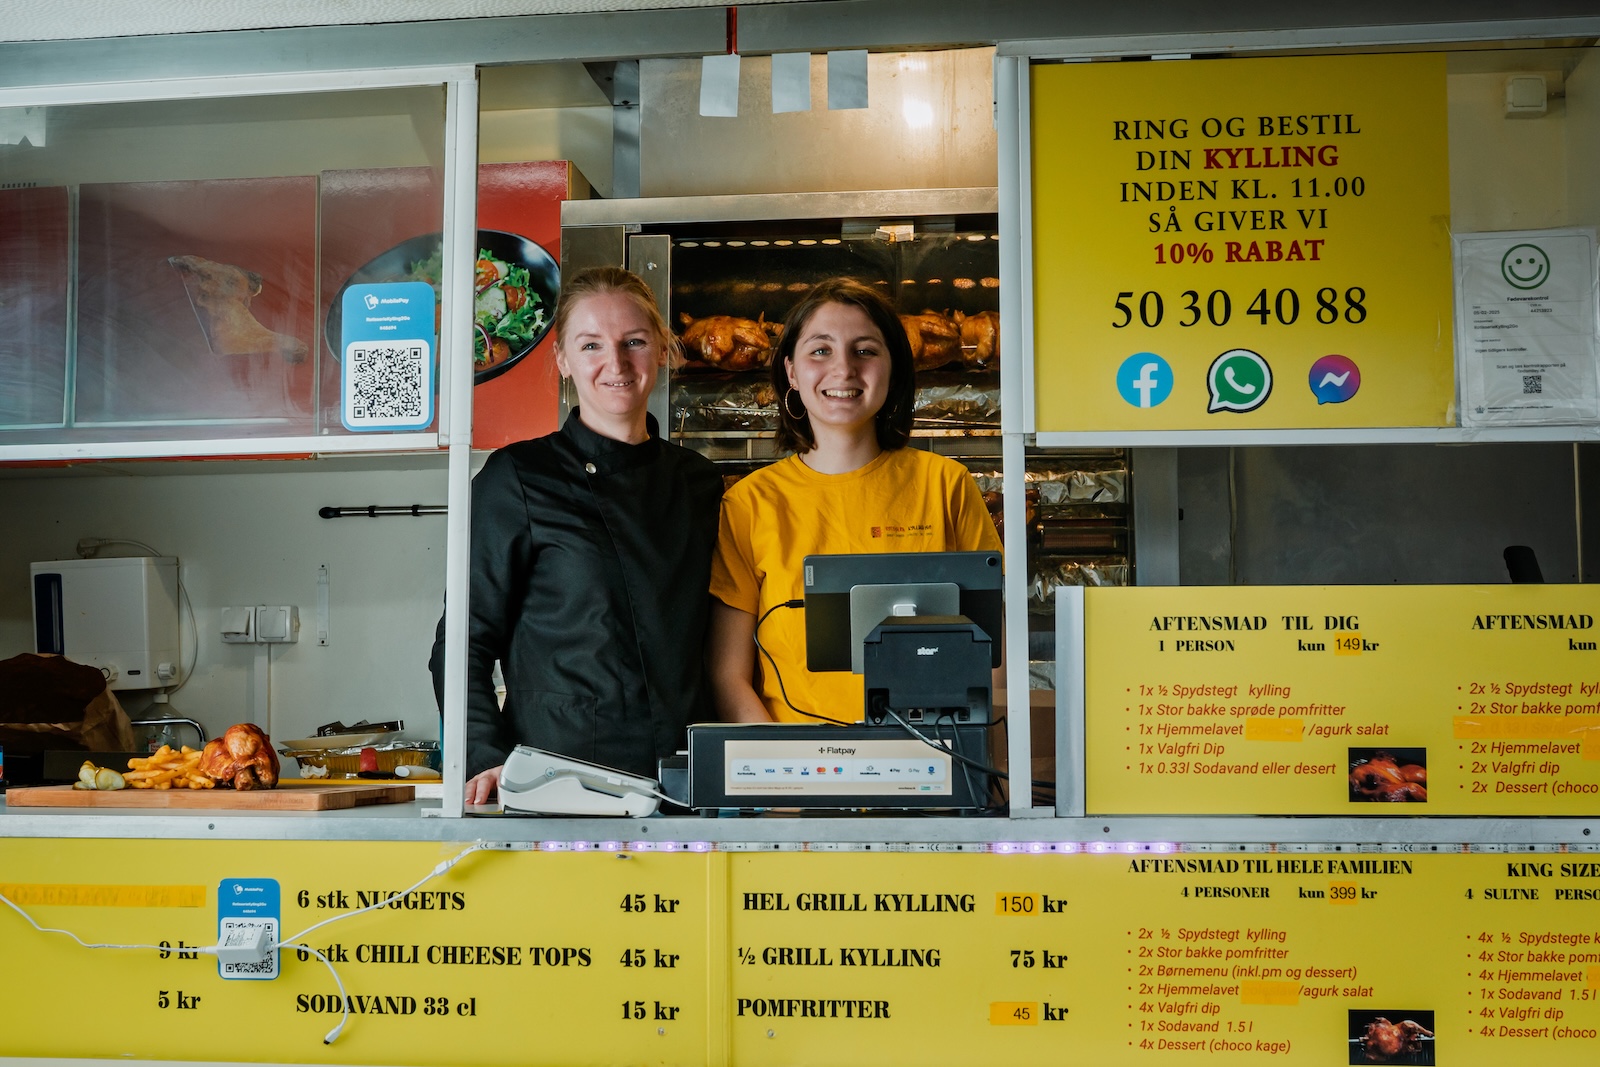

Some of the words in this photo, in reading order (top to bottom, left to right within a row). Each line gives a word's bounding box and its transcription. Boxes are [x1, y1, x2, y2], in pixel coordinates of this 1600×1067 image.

[1113, 119, 1189, 140] RING
[1201, 117, 1246, 138] OG
[1257, 114, 1361, 136] BESTIL
[1135, 150, 1192, 170] DIN
[1202, 145, 1340, 169] KYLLING
[1119, 180, 1219, 202] INDEN
[1230, 179, 1277, 199] KL.
[1291, 177, 1366, 197] 11.00
[1148, 206, 1183, 232] SÅ
[1194, 210, 1288, 231] GIVER
[1296, 209, 1328, 229] VI
[1153, 243, 1214, 264] 10%
[1224, 239, 1326, 262] RABAT
[1111, 291, 1164, 328] 50
[1179, 290, 1232, 327] 30
[1245, 288, 1300, 325] 40
[1315, 287, 1367, 324] 88
[1149, 617, 1268, 630] AFTENSMAD
[1281, 616, 1314, 630] TIL
[1324, 616, 1359, 630] DIG
[1469, 615, 1594, 629] AFTENSMAD
[1176, 640, 1235, 651] PERSON
[1297, 639, 1326, 651] kun
[1568, 638, 1598, 650] kun
[1139, 685, 1154, 696] 1x
[1171, 684, 1239, 699] Spydstegt
[1248, 684, 1291, 699] kylling
[1138, 704, 1154, 715] 1x
[1156, 704, 1185, 715] Stor
[1186, 704, 1227, 715] bakke
[1229, 704, 1276, 718] sprøde
[1278, 703, 1347, 718] pomfritter
[1138, 724, 1154, 735] 1x
[1156, 723, 1244, 738] Hjemmelavet
[1355, 723, 1390, 735] salat
[827, 746, 856, 756] Flatpay
[1139, 743, 1154, 754] 1x
[1157, 742, 1200, 757] Valgfri
[1203, 743, 1225, 757] Dip
[1139, 762, 1154, 773] 1x
[1192, 762, 1259, 774] Sodavand
[1261, 762, 1292, 774] eller
[1293, 762, 1337, 774] desert
[1471, 781, 1489, 793] 2x
[1495, 781, 1549, 793] Dessert
[1551, 781, 1599, 796] (choco
[1125, 860, 1240, 873] AFTENSMAD
[1242, 860, 1273, 873] TIL
[1276, 860, 1324, 873] HELE
[1327, 860, 1413, 874] FAMILIEN
[1507, 863, 1553, 877] KING
[1560, 864, 1600, 877] SIZE
[297, 890, 310, 908] 6
[316, 890, 350, 908] stk
[355, 891, 466, 910] NUGGETS
[1180, 887, 1190, 897] 4
[1194, 887, 1270, 898] PERSONER
[1298, 887, 1325, 898] kun
[1329, 887, 1357, 899] 399
[1361, 887, 1378, 898] kr
[1463, 889, 1474, 899] 4
[1484, 889, 1540, 899] SULTNE
[619, 894, 647, 912] 45
[653, 894, 680, 913] kr
[742, 893, 790, 910] HEL
[796, 893, 868, 911] GRILL
[873, 894, 976, 912] KYLLING
[1000, 896, 1034, 912] 150
[1041, 895, 1068, 912] kr
[1137, 928, 1154, 939] 2x
[1177, 928, 1241, 942] Spydstegt
[1246, 928, 1287, 943] kylling
[158, 941, 172, 959] 9
[177, 941, 199, 959] kr
[296, 944, 310, 961] 6
[316, 944, 350, 962] stk
[355, 944, 420, 963] CHILI
[426, 946, 522, 965] CHEESE
[529, 947, 592, 966] TOPS
[762, 947, 833, 965] GRILL
[839, 948, 941, 967] KYLLING
[1138, 946, 1154, 957] 2x
[1156, 946, 1183, 957] Stor
[1185, 946, 1223, 958] bakke
[1225, 947, 1290, 961] pomfritter
[619, 949, 647, 967] 45
[653, 949, 680, 968] kr
[1010, 950, 1036, 968] 75
[1042, 950, 1069, 968] kr
[1138, 965, 1154, 976] 2x
[1156, 965, 1229, 976] Børnemenu
[1231, 965, 1283, 980] (inkl.pm
[1285, 969, 1302, 980] og
[1304, 966, 1358, 981] dessert)
[1138, 983, 1154, 994] 2x
[1157, 984, 1240, 997] Hjemmelavet
[1342, 986, 1374, 997] salat
[1480, 988, 1495, 999] 1x
[1497, 988, 1563, 1000] Sodavand
[1569, 989, 1590, 1000] 1.5
[157, 991, 170, 1008] 5
[176, 991, 202, 1009] kr
[296, 994, 417, 1014] SODAVAND
[423, 997, 450, 1015] 33
[456, 998, 477, 1016] cl
[621, 1001, 647, 1019] 15
[653, 1001, 680, 1020] kr
[736, 999, 892, 1018] POMFRITTER
[1013, 1008, 1031, 1020] 45
[1042, 1003, 1069, 1021] kr
[1138, 1002, 1155, 1012] 4x
[1157, 1002, 1199, 1016] Valgfri
[1201, 1002, 1221, 1016] dip
[1479, 1007, 1496, 1018] 4x
[1499, 1007, 1541, 1021] Valgfri
[1543, 1007, 1564, 1022] dip
[1140, 1020, 1155, 1031] 1x
[1157, 1020, 1220, 1032] Sodavand
[1227, 1021, 1247, 1032] 1.5
[1479, 1026, 1496, 1037] 4x
[1498, 1026, 1550, 1037] Dessert
[1552, 1026, 1597, 1040] (choco
[1139, 1039, 1155, 1049] 4x
[1157, 1039, 1207, 1050] Dessert
[1209, 1039, 1253, 1053] (choco
[1255, 1040, 1291, 1054] kage)
